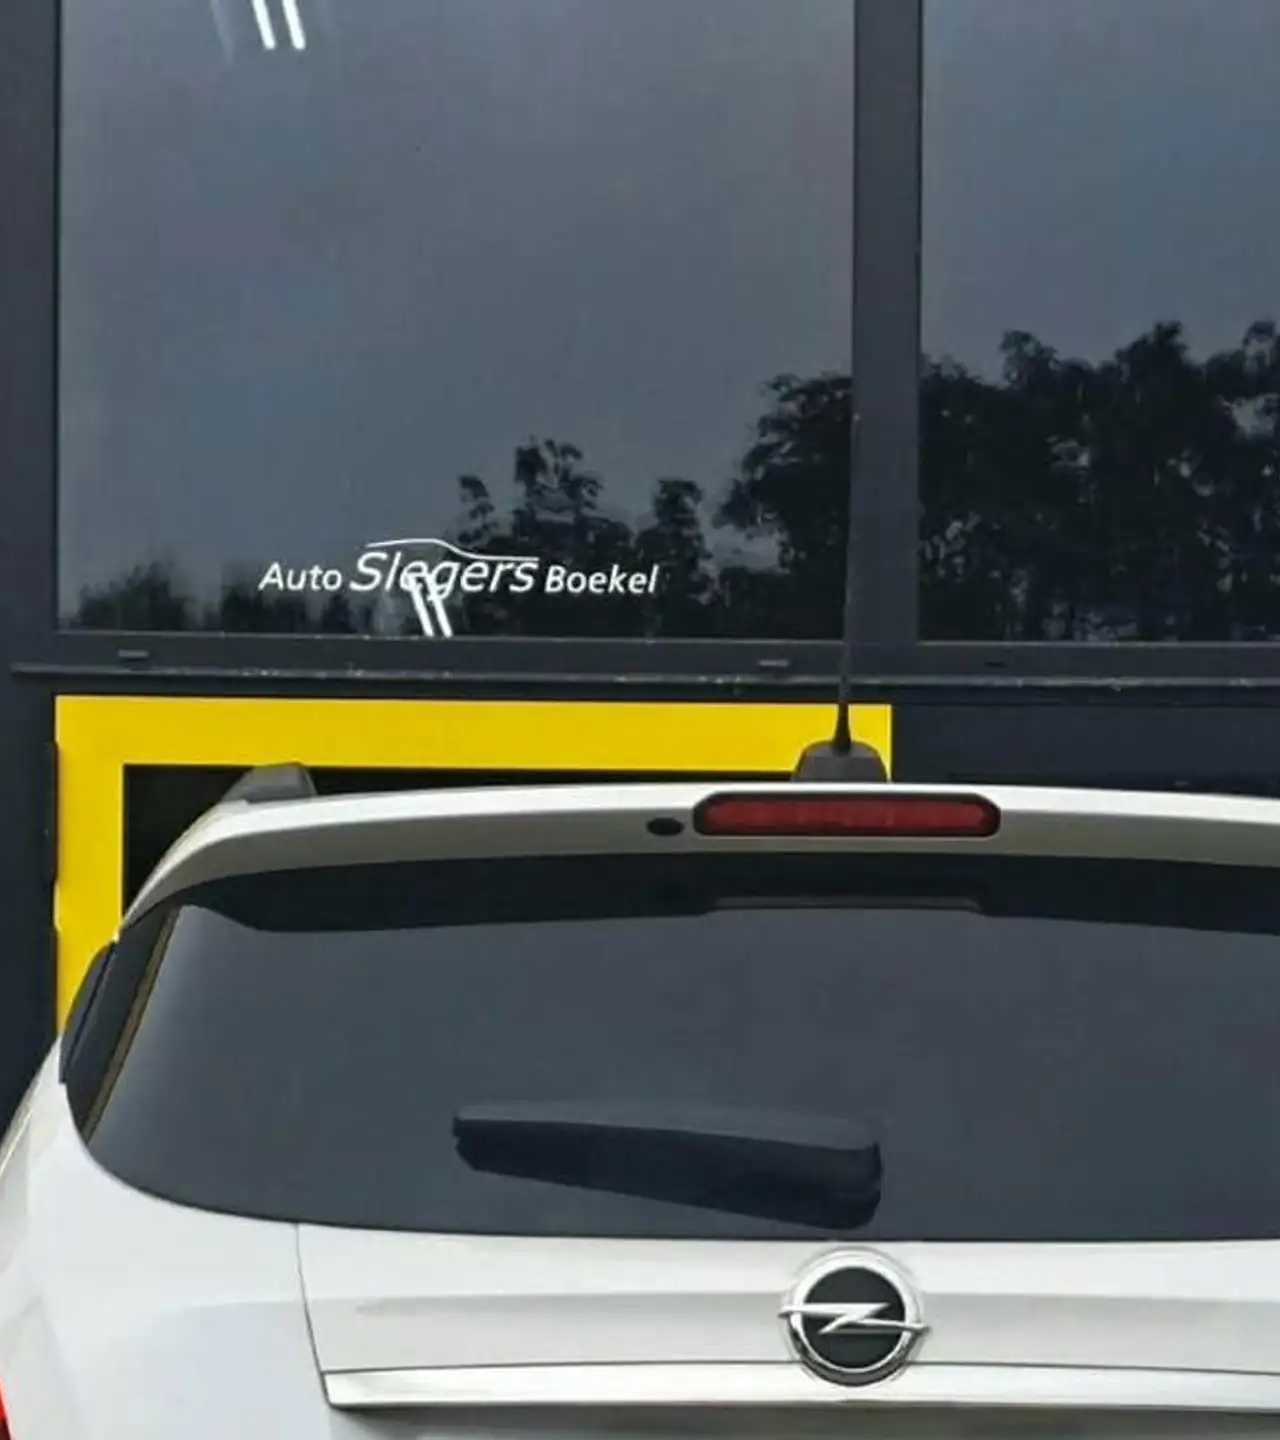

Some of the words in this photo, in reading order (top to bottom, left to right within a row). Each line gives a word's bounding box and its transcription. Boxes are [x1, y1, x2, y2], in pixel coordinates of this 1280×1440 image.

[258, 562, 342, 591] Auto
[349, 550, 538, 601] Slegers
[544, 564, 659, 594] Boekel
